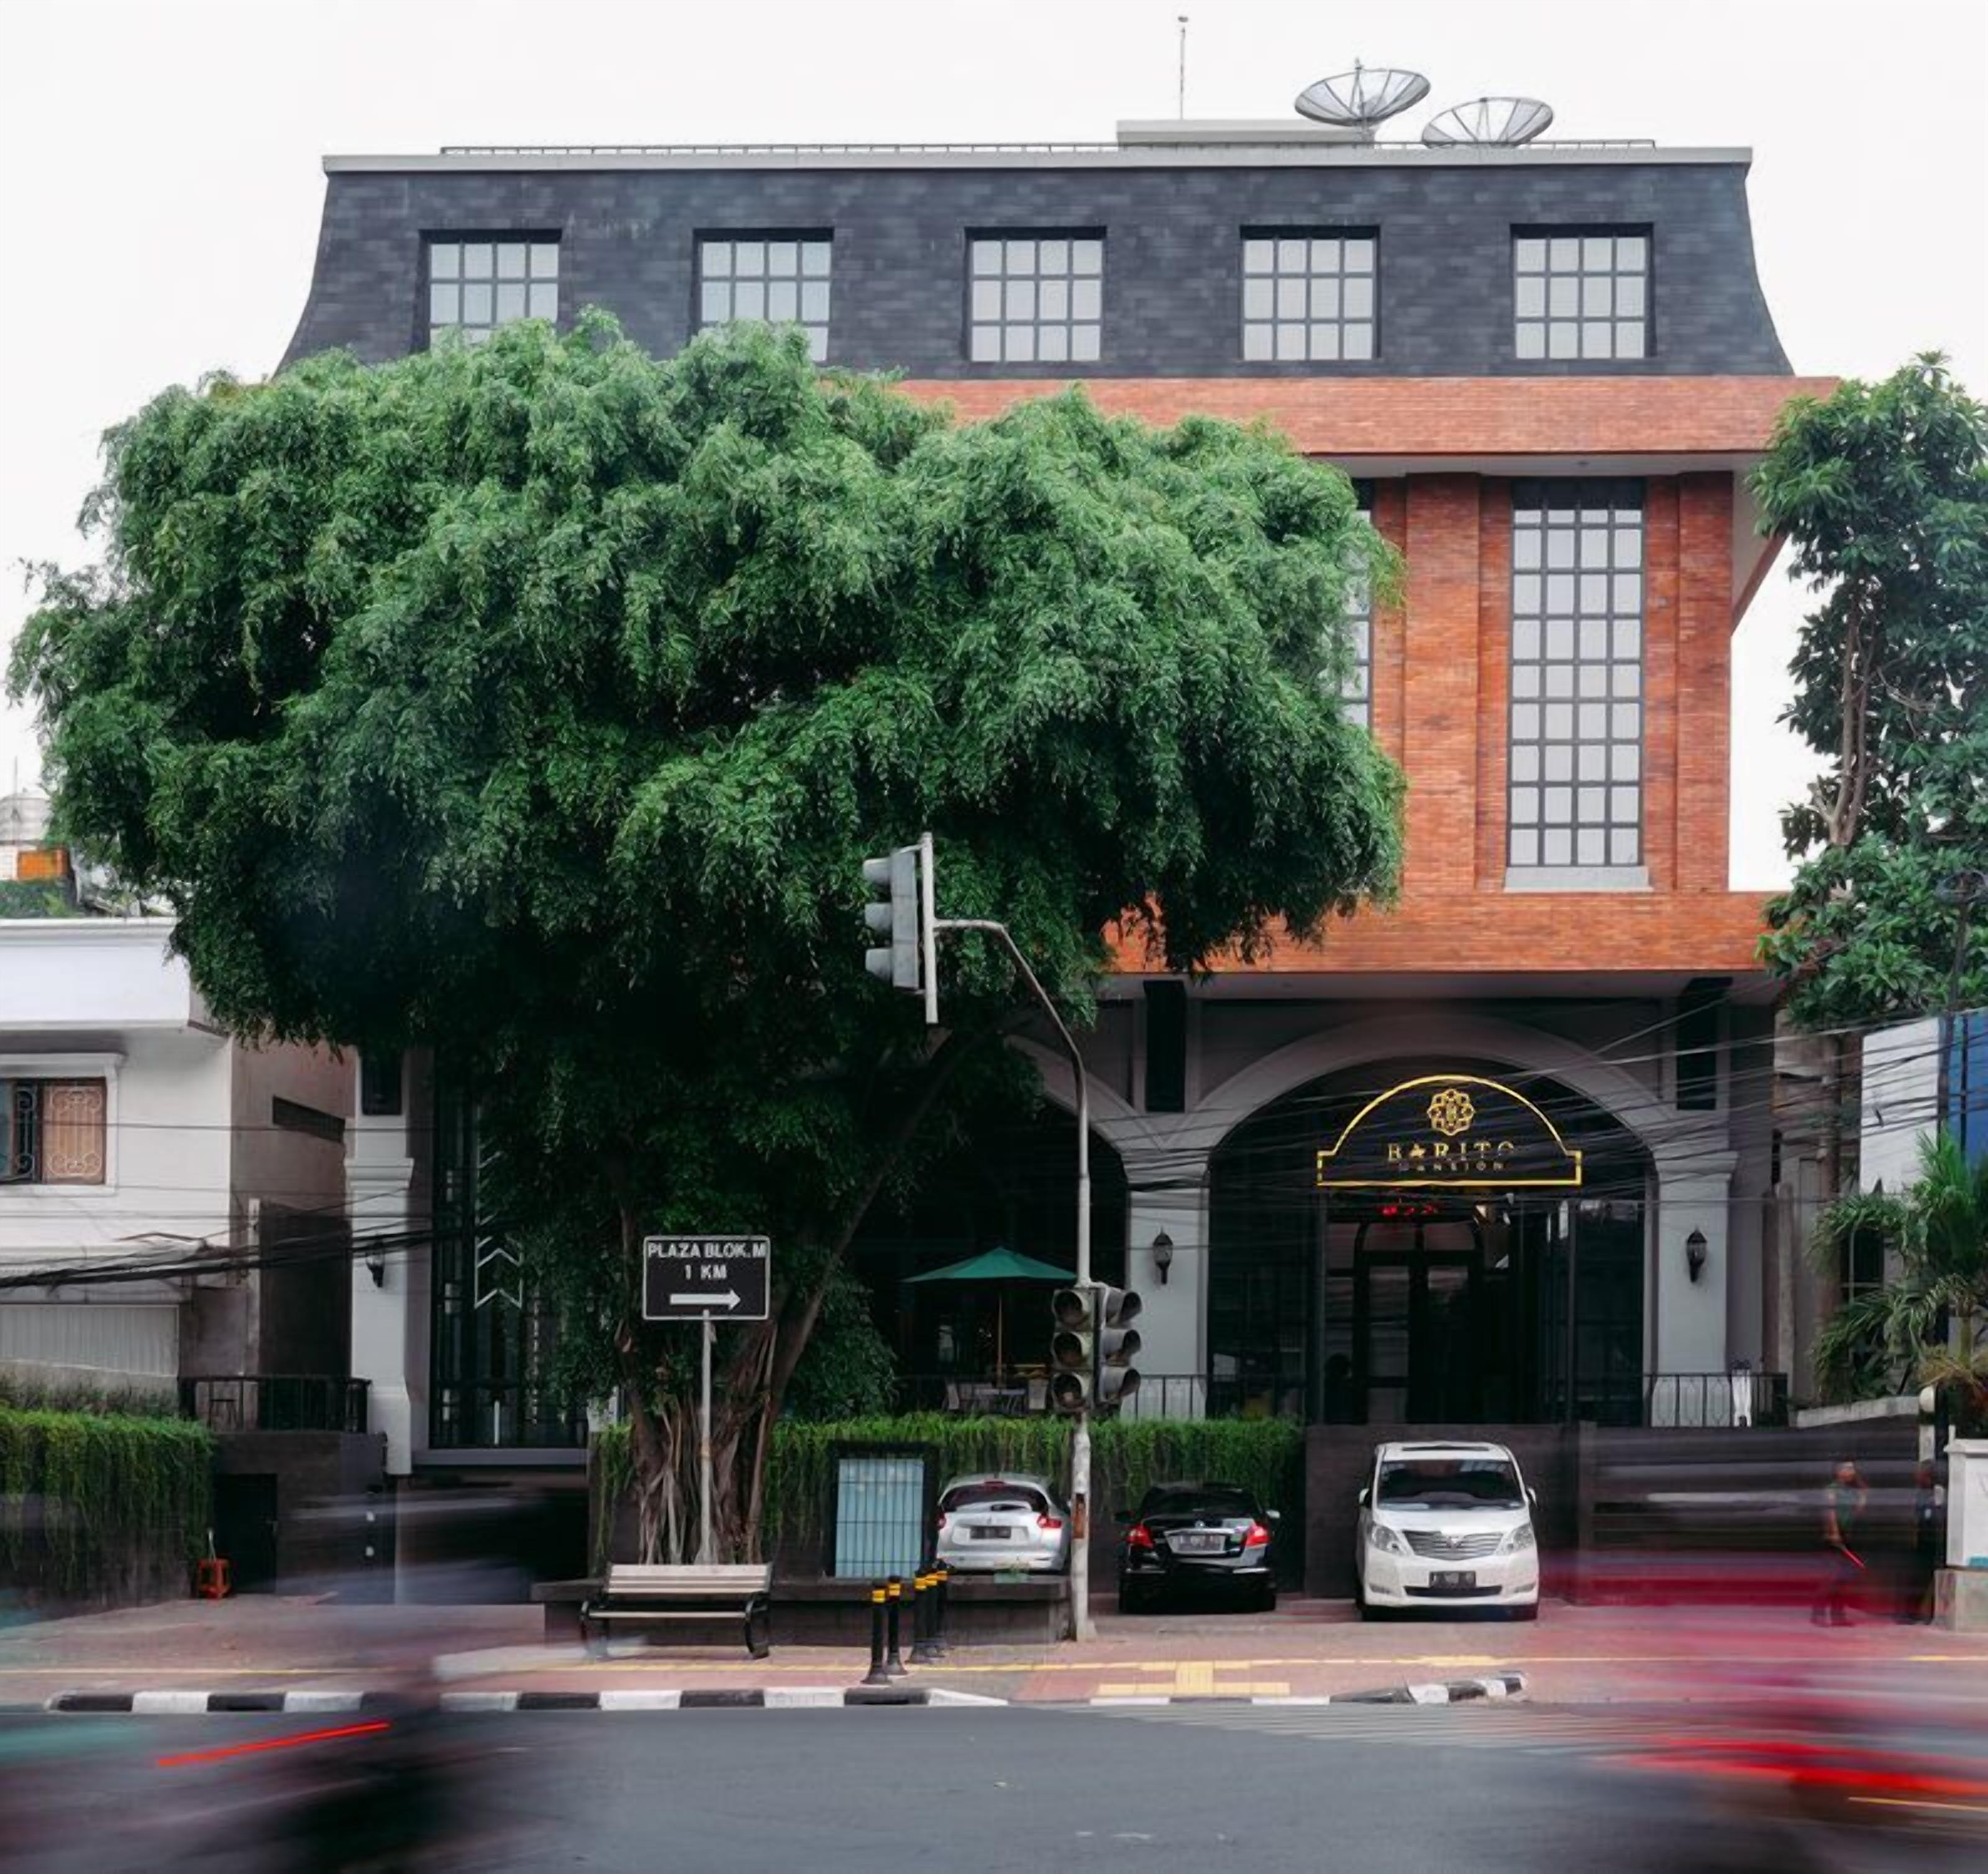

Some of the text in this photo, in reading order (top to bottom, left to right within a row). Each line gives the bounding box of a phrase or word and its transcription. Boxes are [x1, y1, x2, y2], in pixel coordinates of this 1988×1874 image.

[648, 1243, 701, 1258] PLAZA
[685, 1264, 727, 1280] 1 KM
